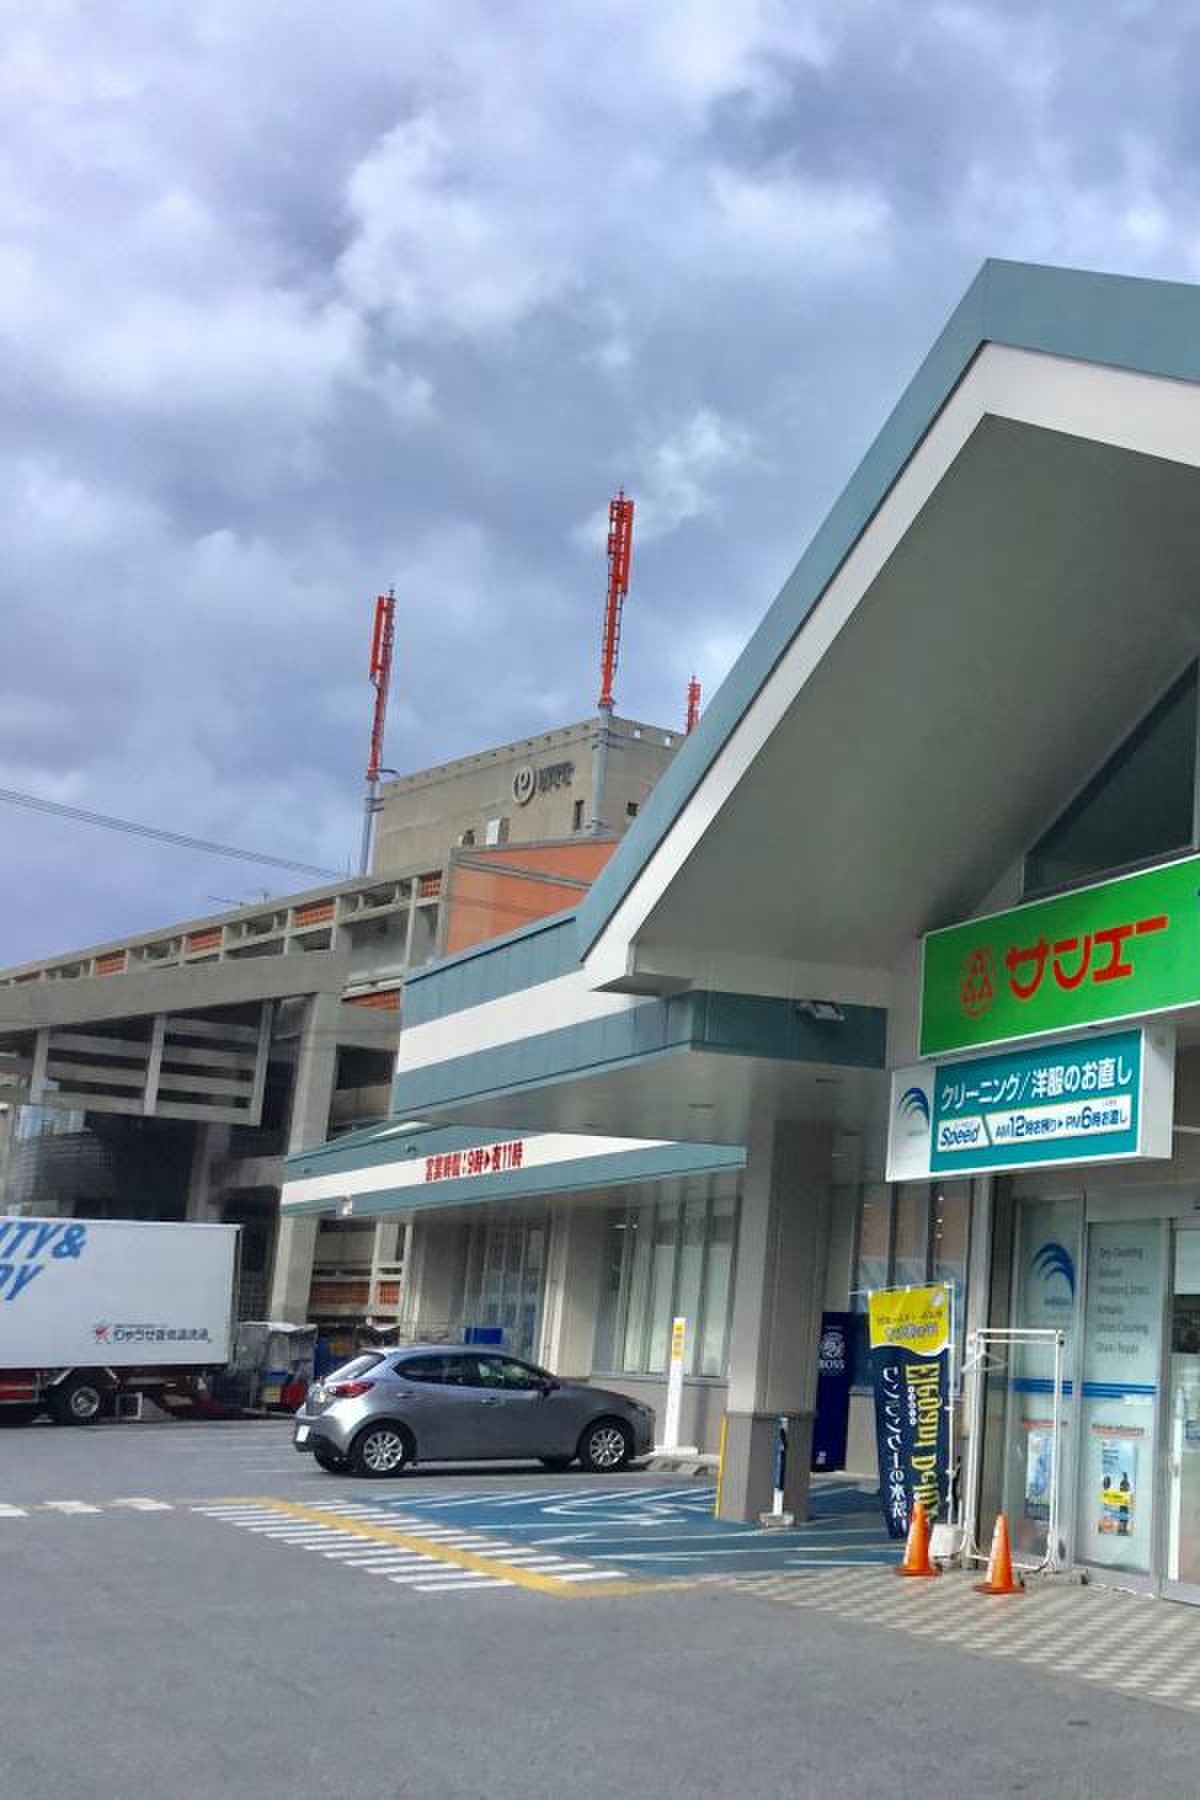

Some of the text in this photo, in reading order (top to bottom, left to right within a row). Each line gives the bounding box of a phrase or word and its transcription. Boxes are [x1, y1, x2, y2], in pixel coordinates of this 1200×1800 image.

[1005, 914, 1168, 1001] サンエー
[940, 1122, 980, 1146] Speed
